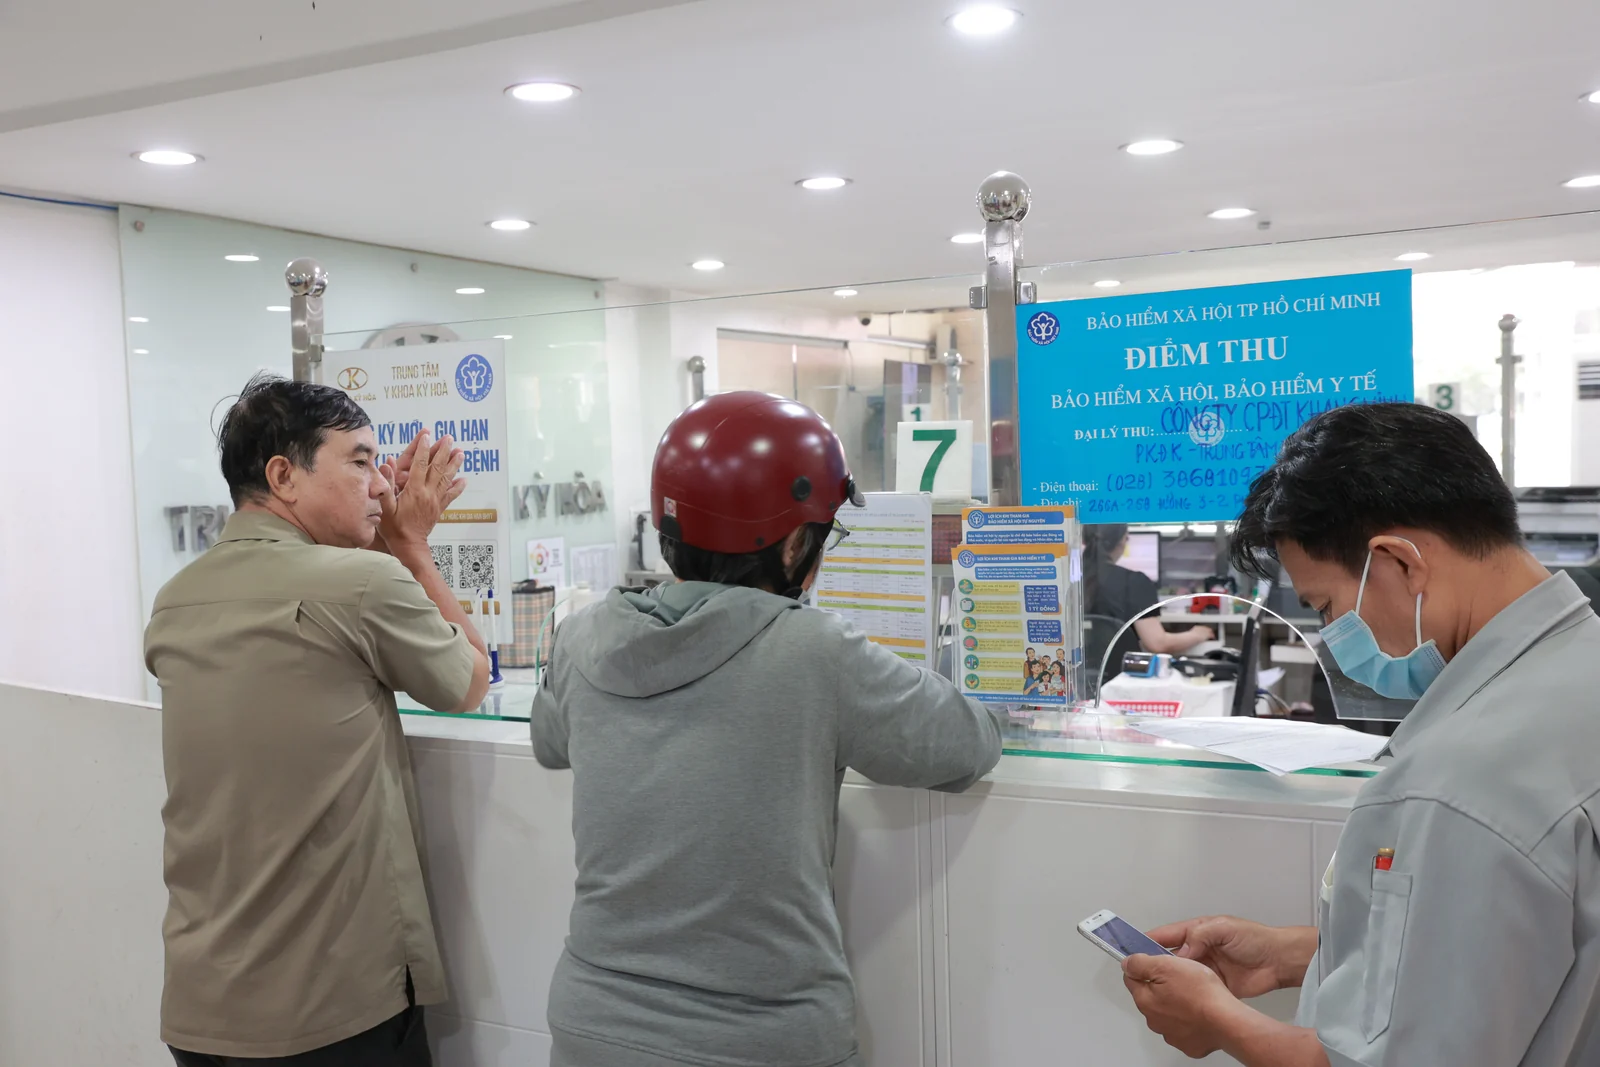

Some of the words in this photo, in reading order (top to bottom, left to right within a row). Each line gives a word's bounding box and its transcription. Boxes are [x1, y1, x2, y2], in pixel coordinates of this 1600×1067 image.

[1087, 312, 1122, 330] BẢO
[1126, 306, 1168, 327] HIỂM
[1173, 305, 1198, 323] XÃ
[1202, 302, 1233, 321] HỘI
[1237, 303, 1258, 318] TP
[1263, 294, 1289, 315] HỒ
[1293, 293, 1325, 313] CHÍ
[1330, 292, 1381, 310] MINH
[1124, 338, 1210, 370] ĐIỂM
[1217, 335, 1289, 364] THU
[392, 365, 419, 380] TRUNG
[421, 362, 440, 379] TÂM
[383, 386, 390, 399] Y
[391, 384, 415, 399] KHOA
[416, 381, 429, 398] KỲ
[430, 380, 449, 397] HOÀ
[1051, 389, 1090, 409] BẢO
[1094, 384, 1142, 407] HIỂM
[1147, 385, 1174, 404] XÃ
[1179, 382, 1219, 405] HỘI,
[1224, 378, 1266, 399] BẢO
[1271, 372, 1324, 395] HIỂM
[1329, 376, 1345, 392] Y
[1350, 368, 1377, 391] TẾ
[1435, 385, 1454, 410] 3
[911, 407, 921, 421] 1
[378, 420, 395, 445] KÝ
[435, 420, 457, 442] GIA
[460, 419, 489, 445] HẠN
[1074, 429, 1097, 442] ĐẠI
[1101, 425, 1119, 440] LÝ
[464, 447, 500, 476] BỆNH
[912, 429, 957, 493] 7
[1040, 481, 1066, 494] Điện
[1069, 480, 1099, 494] thoại:
